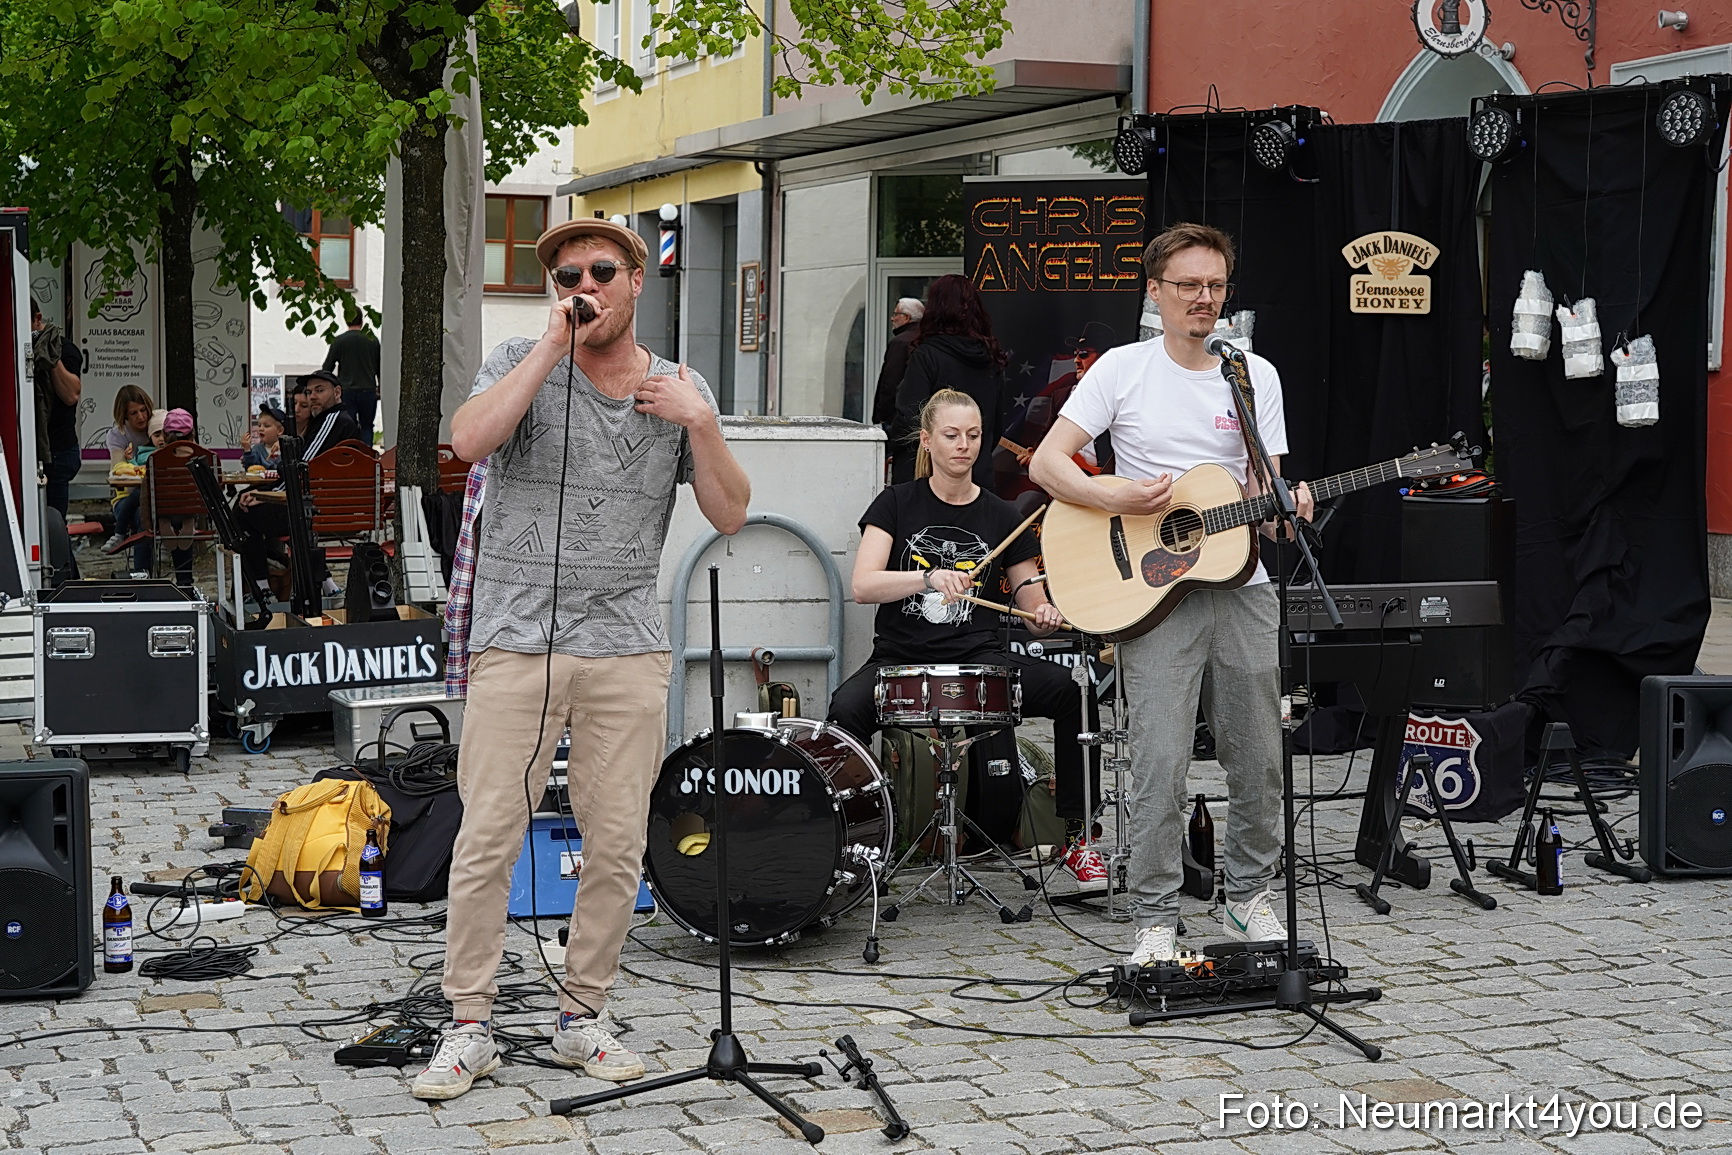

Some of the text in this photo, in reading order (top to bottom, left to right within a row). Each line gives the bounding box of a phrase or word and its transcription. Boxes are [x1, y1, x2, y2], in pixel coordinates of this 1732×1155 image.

[971, 196, 1146, 236] CHRIS
[1351, 235, 1432, 265] JACK DANIEL'S
[972, 241, 1144, 292] ANGELS
[1355, 280, 1425, 296] Tennessee
[1355, 297, 1425, 310] HONEY
[259, 378, 278, 388] SHOP
[243, 635, 438, 690] JACK DANIEL'S
[1405, 724, 1467, 745] ROUTE
[7, 925, 22, 934] RCF
